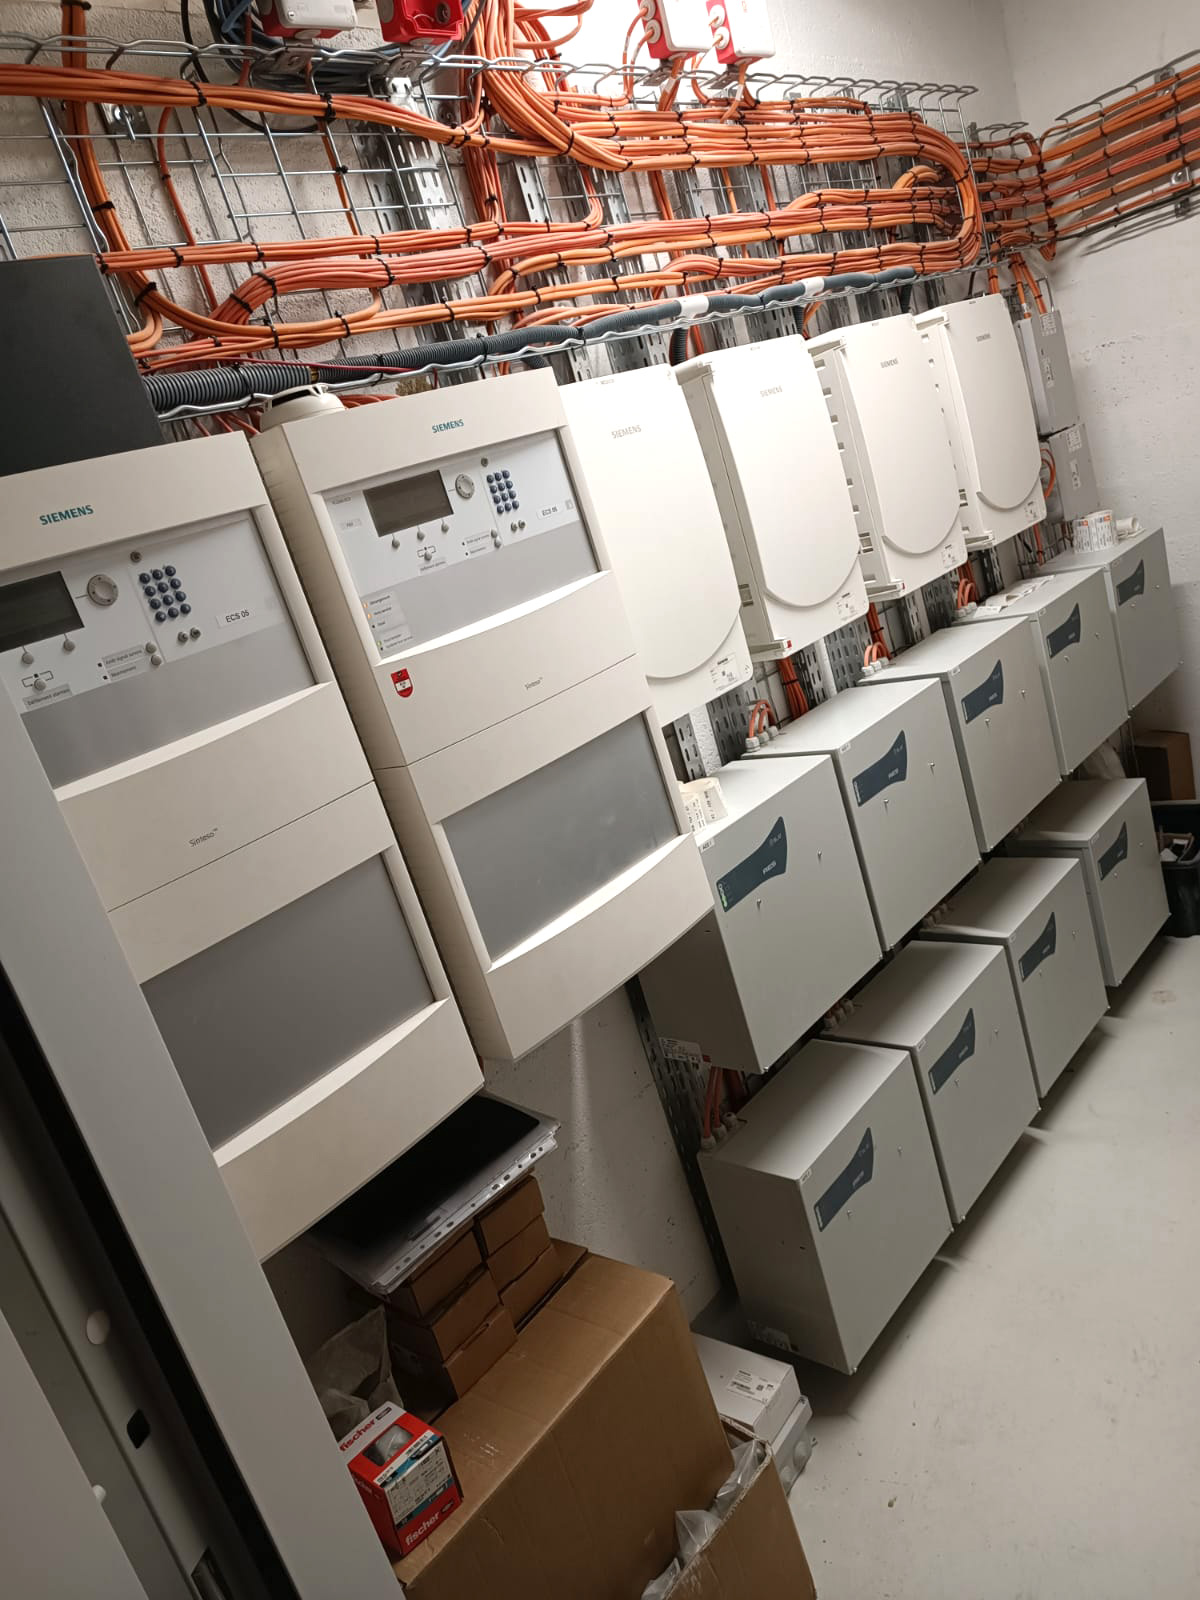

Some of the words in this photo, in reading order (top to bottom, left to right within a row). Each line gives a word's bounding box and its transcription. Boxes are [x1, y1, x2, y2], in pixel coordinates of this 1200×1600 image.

[431, 418, 465, 433] SIEMENS
[611, 424, 642, 439] SIEMENS
[39, 504, 94, 526] SIEMENS
[339, 1418, 377, 1452] fischer
[405, 1511, 441, 1546] fischer
